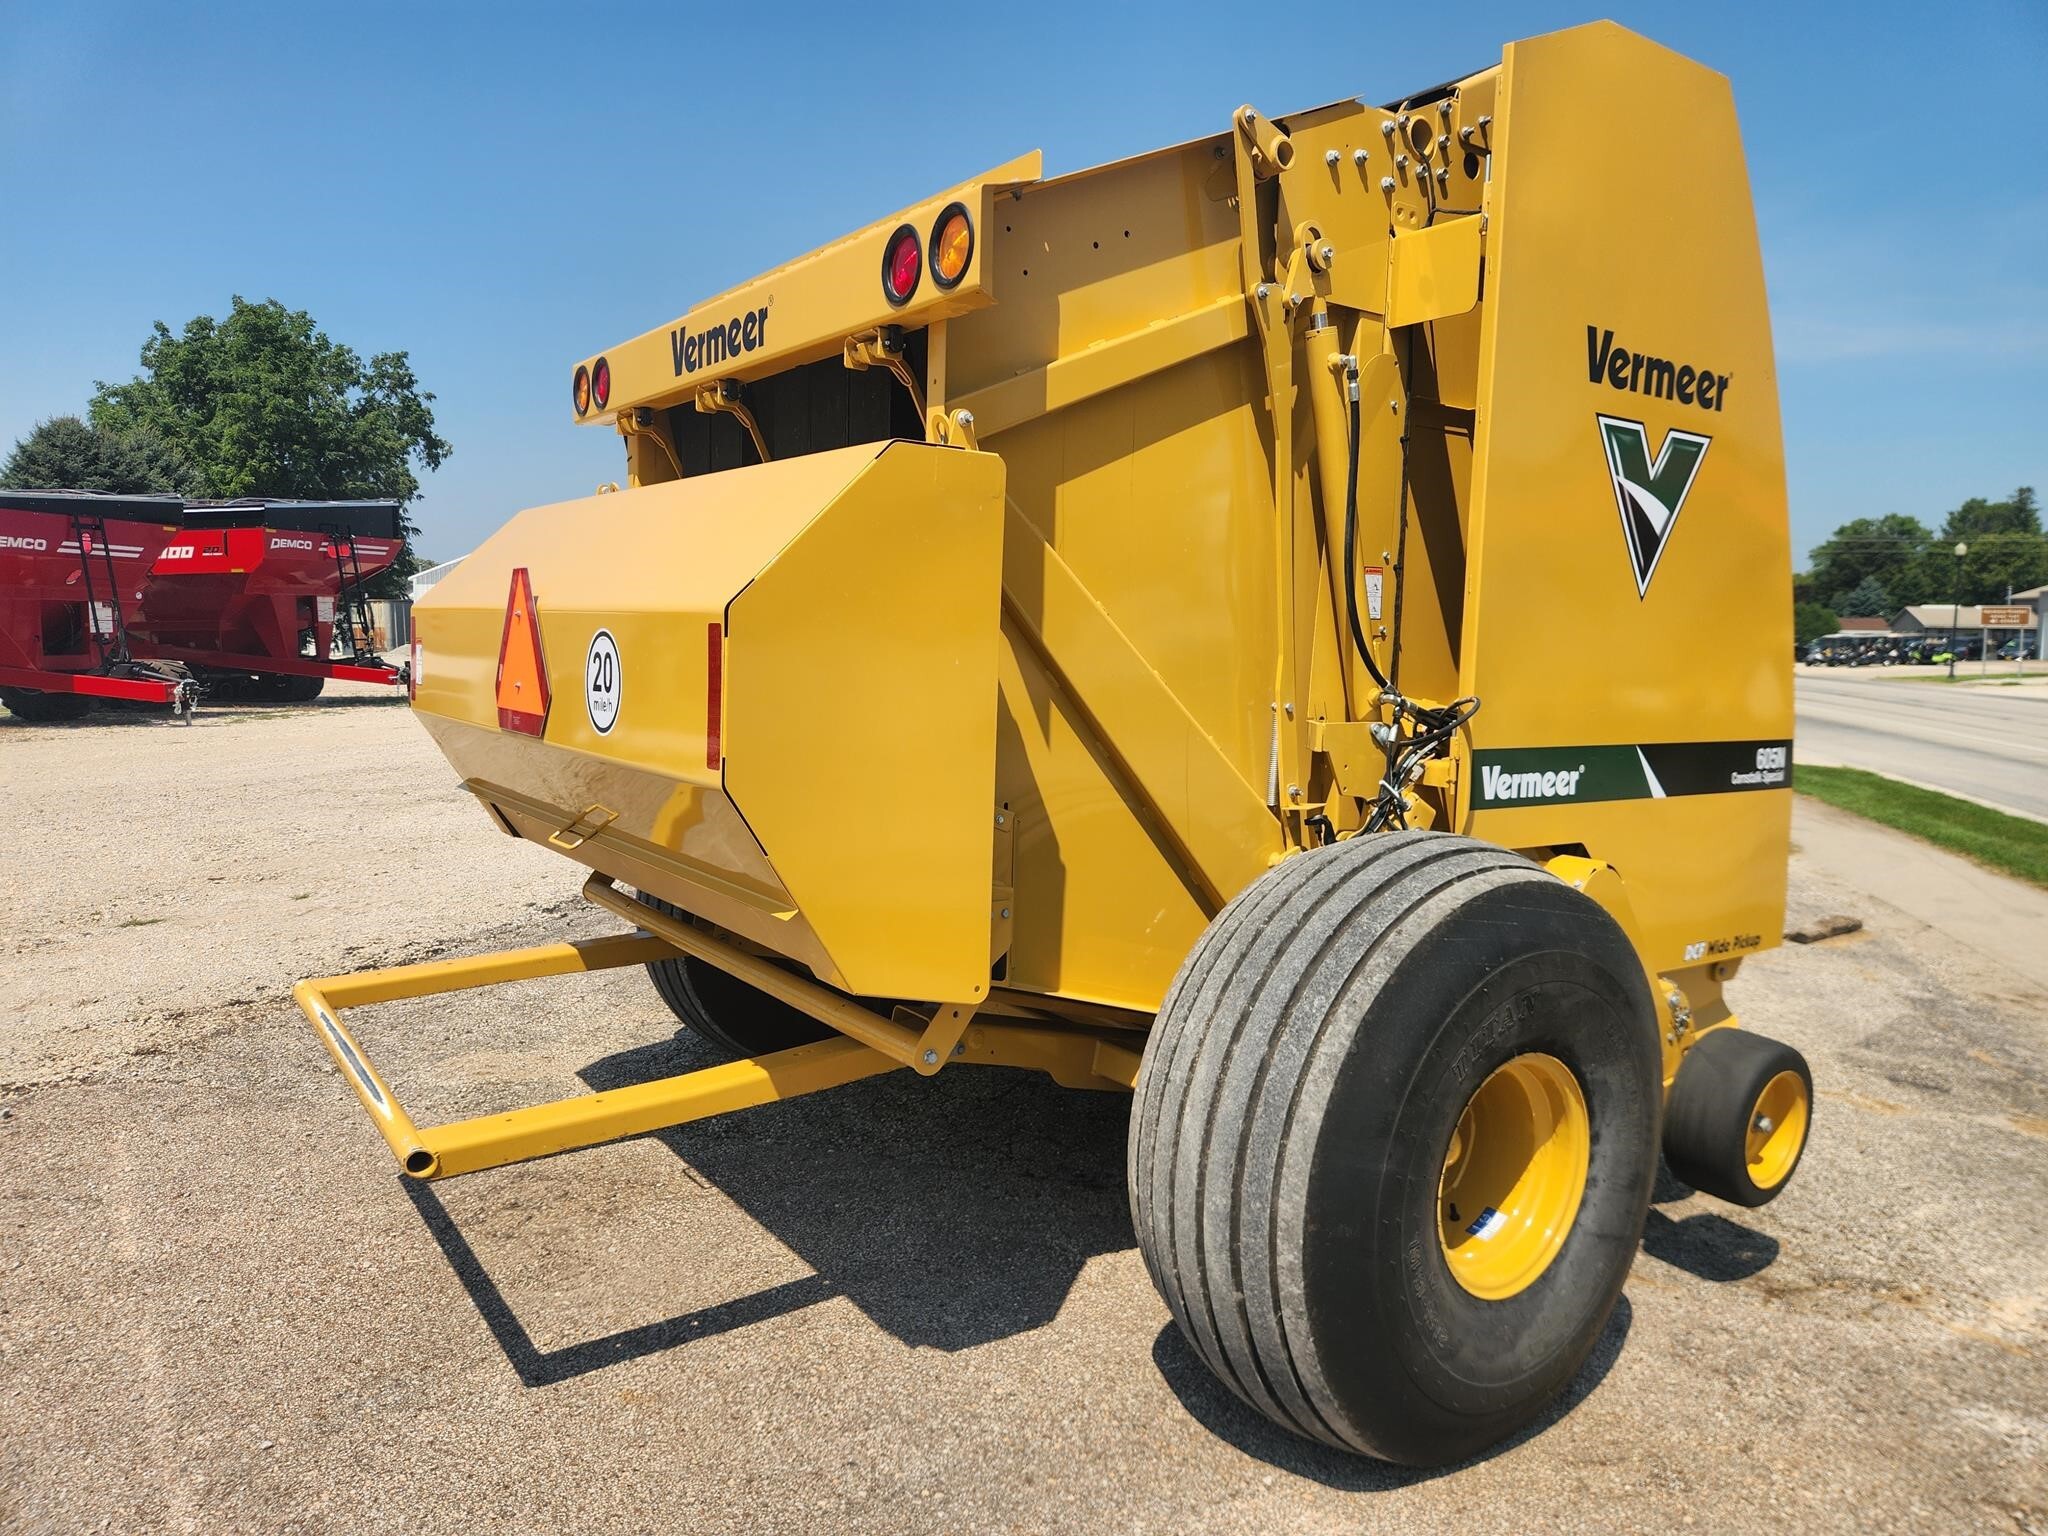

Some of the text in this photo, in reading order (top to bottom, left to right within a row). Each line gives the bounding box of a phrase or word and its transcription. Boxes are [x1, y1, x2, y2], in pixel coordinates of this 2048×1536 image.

[671, 306, 768, 377] Vermeer
[1587, 325, 1729, 412] Vermeer
[270, 538, 313, 550] DEMCO
[592, 651, 613, 693] 20
[1481, 765, 1580, 800] Vermeer
[1449, 990, 1540, 1083] TITAN
